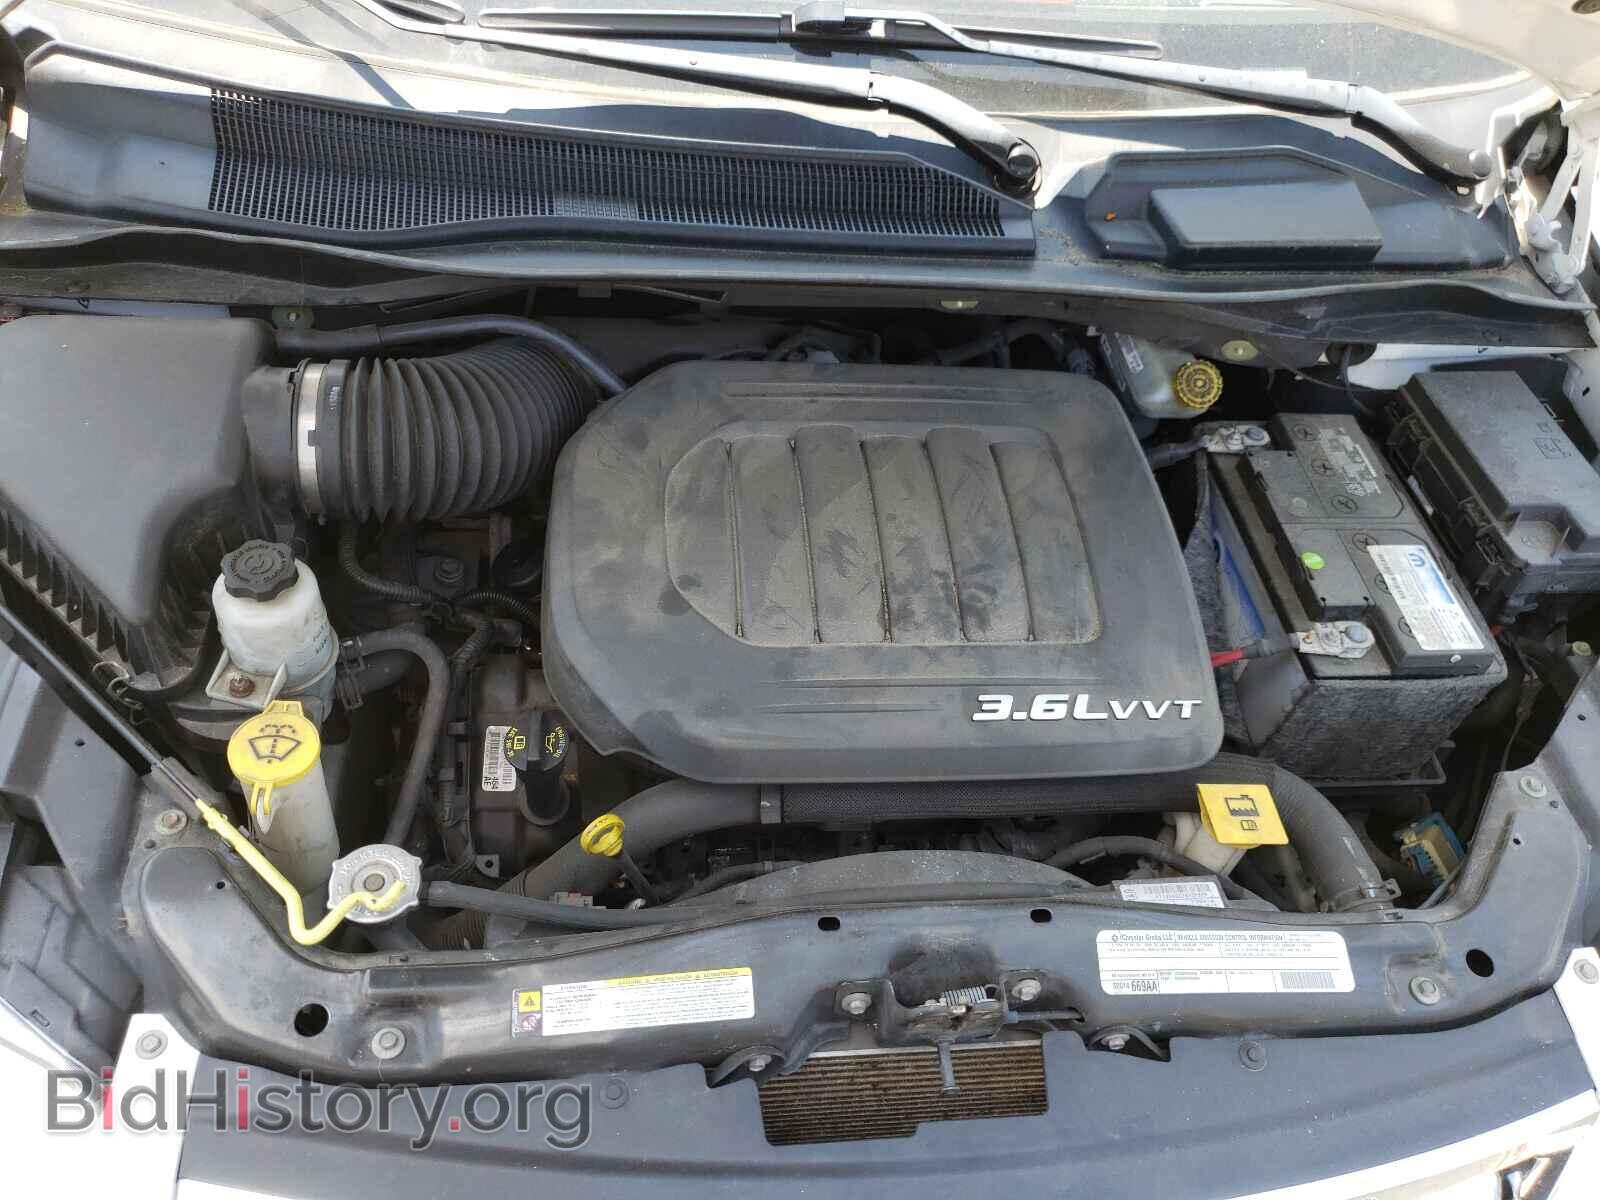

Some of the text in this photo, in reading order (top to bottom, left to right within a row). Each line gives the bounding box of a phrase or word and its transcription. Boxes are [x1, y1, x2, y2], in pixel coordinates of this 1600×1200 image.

[971, 693, 1203, 721] 3.6L VVT
[1131, 980, 1158, 992] 669AA
